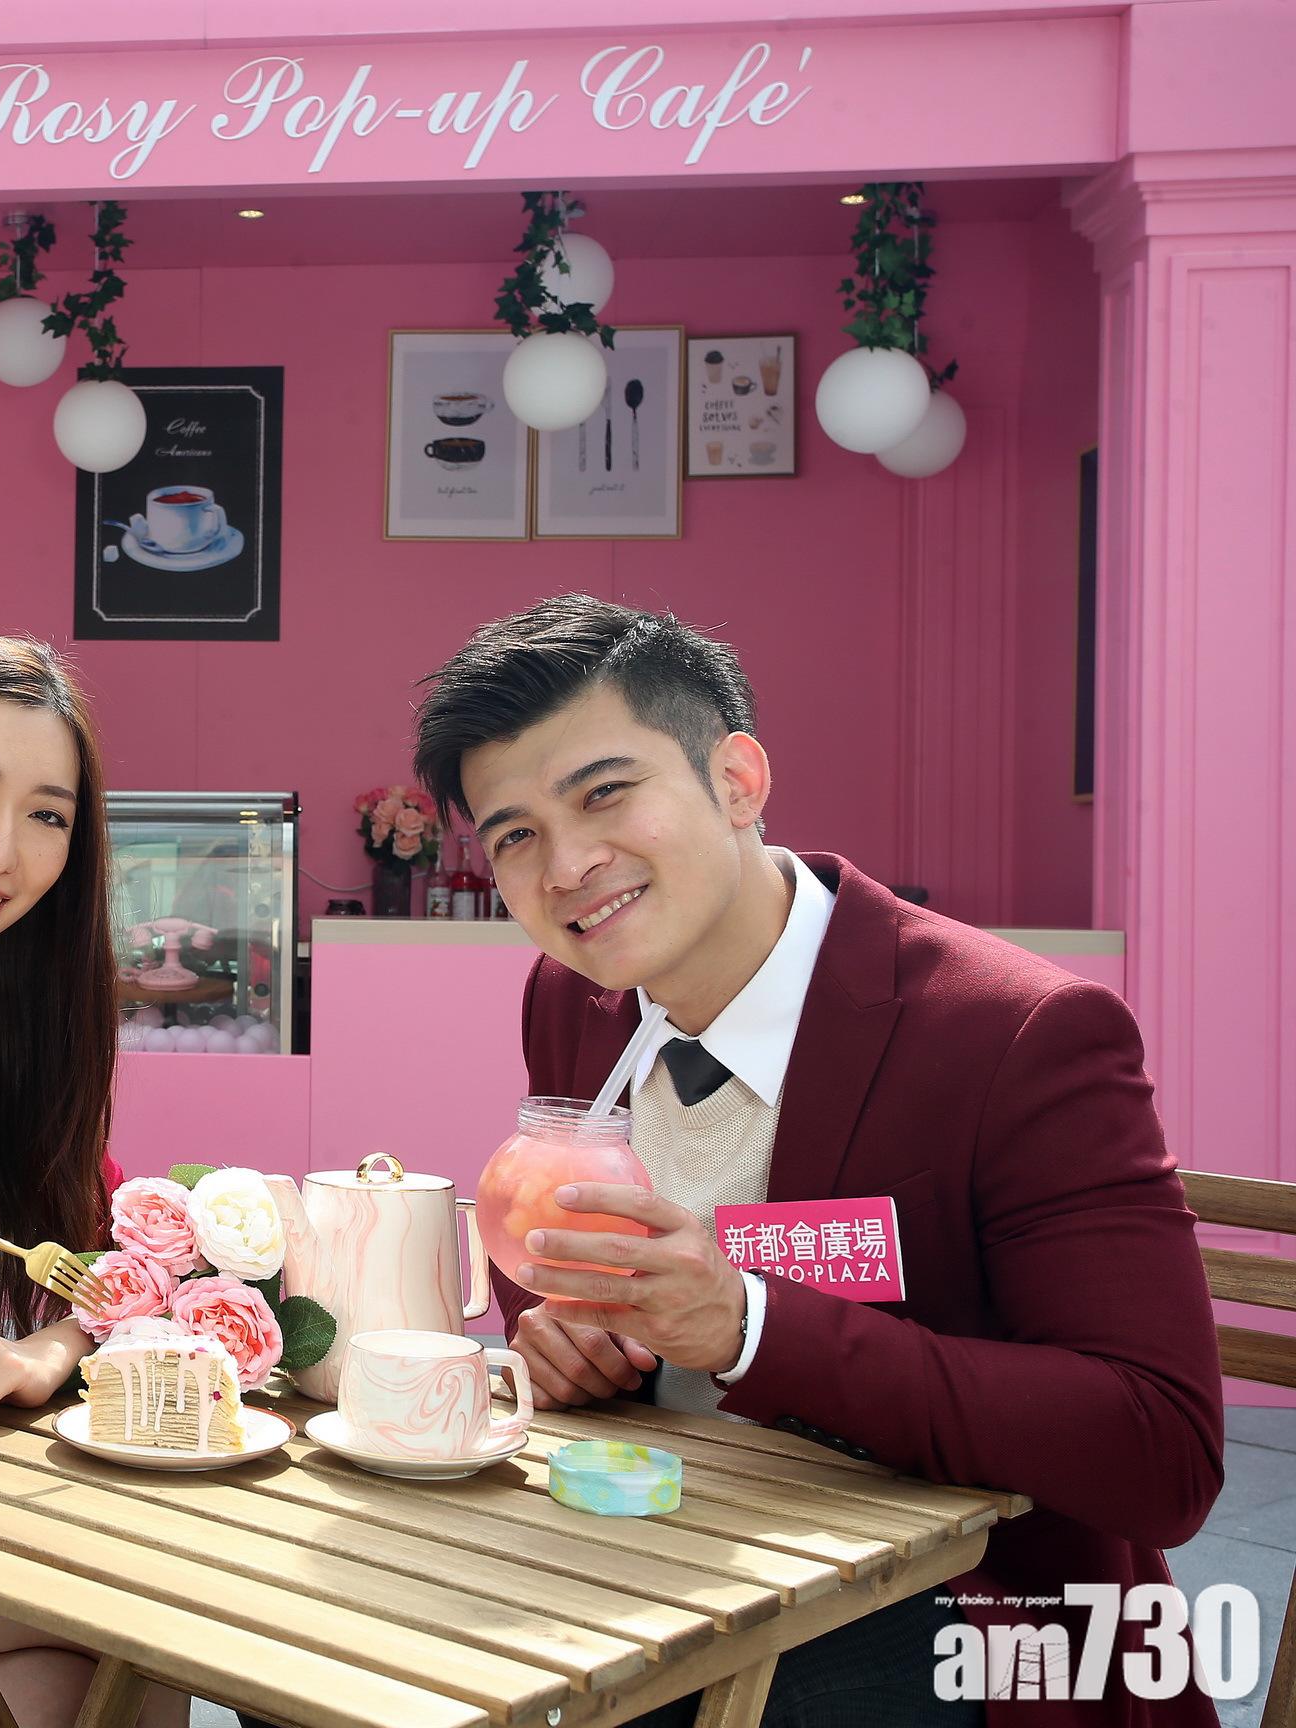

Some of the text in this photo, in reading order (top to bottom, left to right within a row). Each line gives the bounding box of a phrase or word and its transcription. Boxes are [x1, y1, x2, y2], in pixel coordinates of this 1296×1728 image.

[211, 56, 560, 174] Pop-up
[724, 1218, 887, 1264] 新都會廣場
